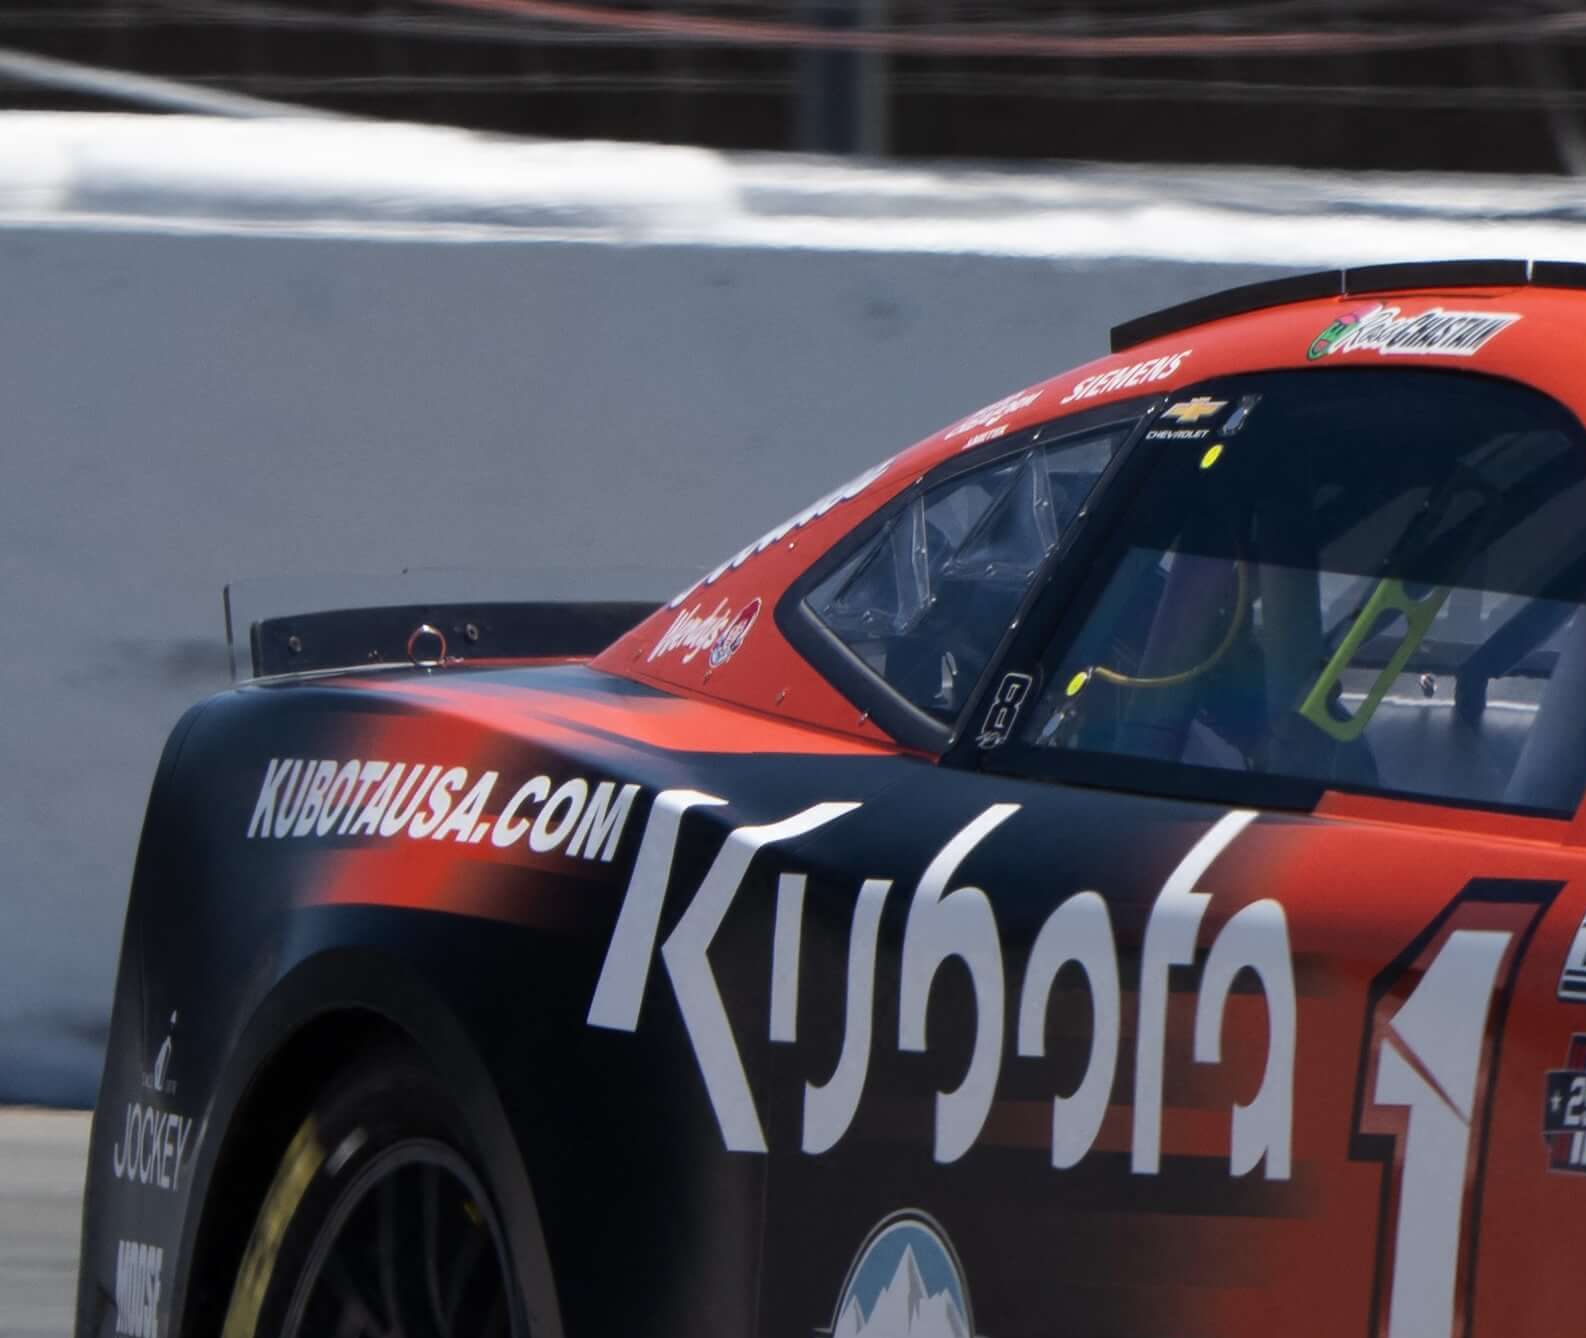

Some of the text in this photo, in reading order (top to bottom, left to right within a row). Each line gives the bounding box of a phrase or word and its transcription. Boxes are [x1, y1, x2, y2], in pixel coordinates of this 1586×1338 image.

[1060, 349, 1193, 404] SIEMENS
[1145, 428, 1210, 440] CHEVROLET
[247, 758, 641, 862] KUBOTAUSA.COM
[586, 789, 1296, 1181] Kubota
[113, 1102, 192, 1192] JOCKEY
